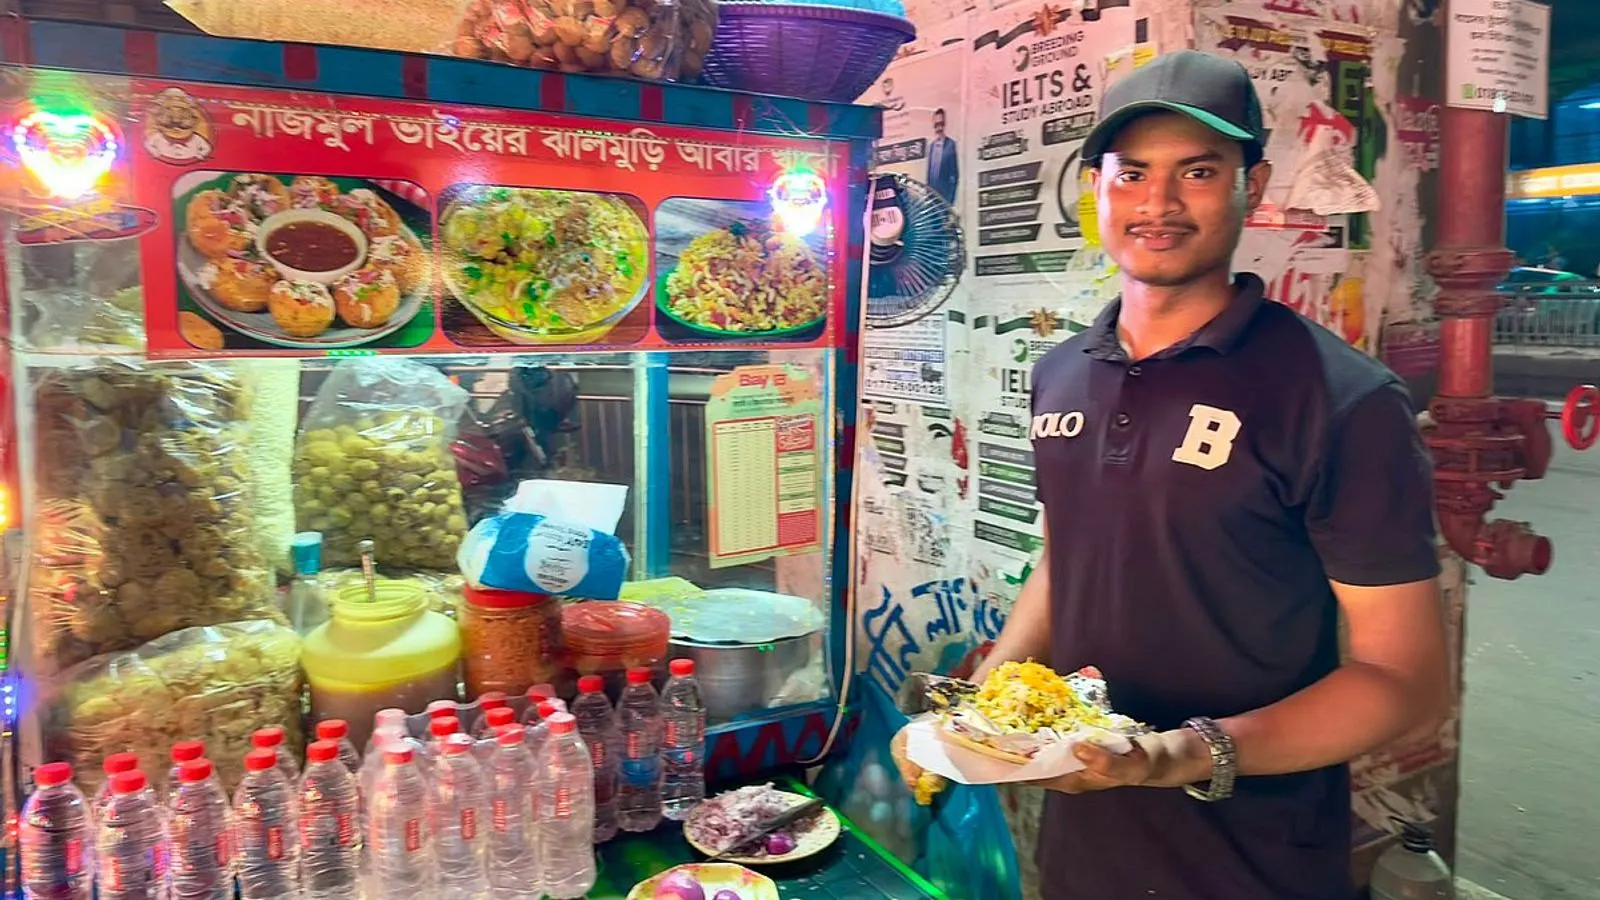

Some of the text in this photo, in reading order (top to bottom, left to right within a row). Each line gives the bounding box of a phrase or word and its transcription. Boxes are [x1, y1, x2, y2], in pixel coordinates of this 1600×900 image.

[1031, 30, 1084, 54] BREEDING
[1032, 45, 1078, 67] GROUND
[1002, 63, 1094, 109] IELTS &
[1002, 94, 1093, 125] STUDY ABROAD
[229, 102, 384, 151] নাজমুল
[386, 109, 533, 155] ভাইয়ের
[540, 126, 668, 172] ঝালমুড়ি
[674, 138, 764, 173] আবার
[1171, 403, 1243, 471] B
